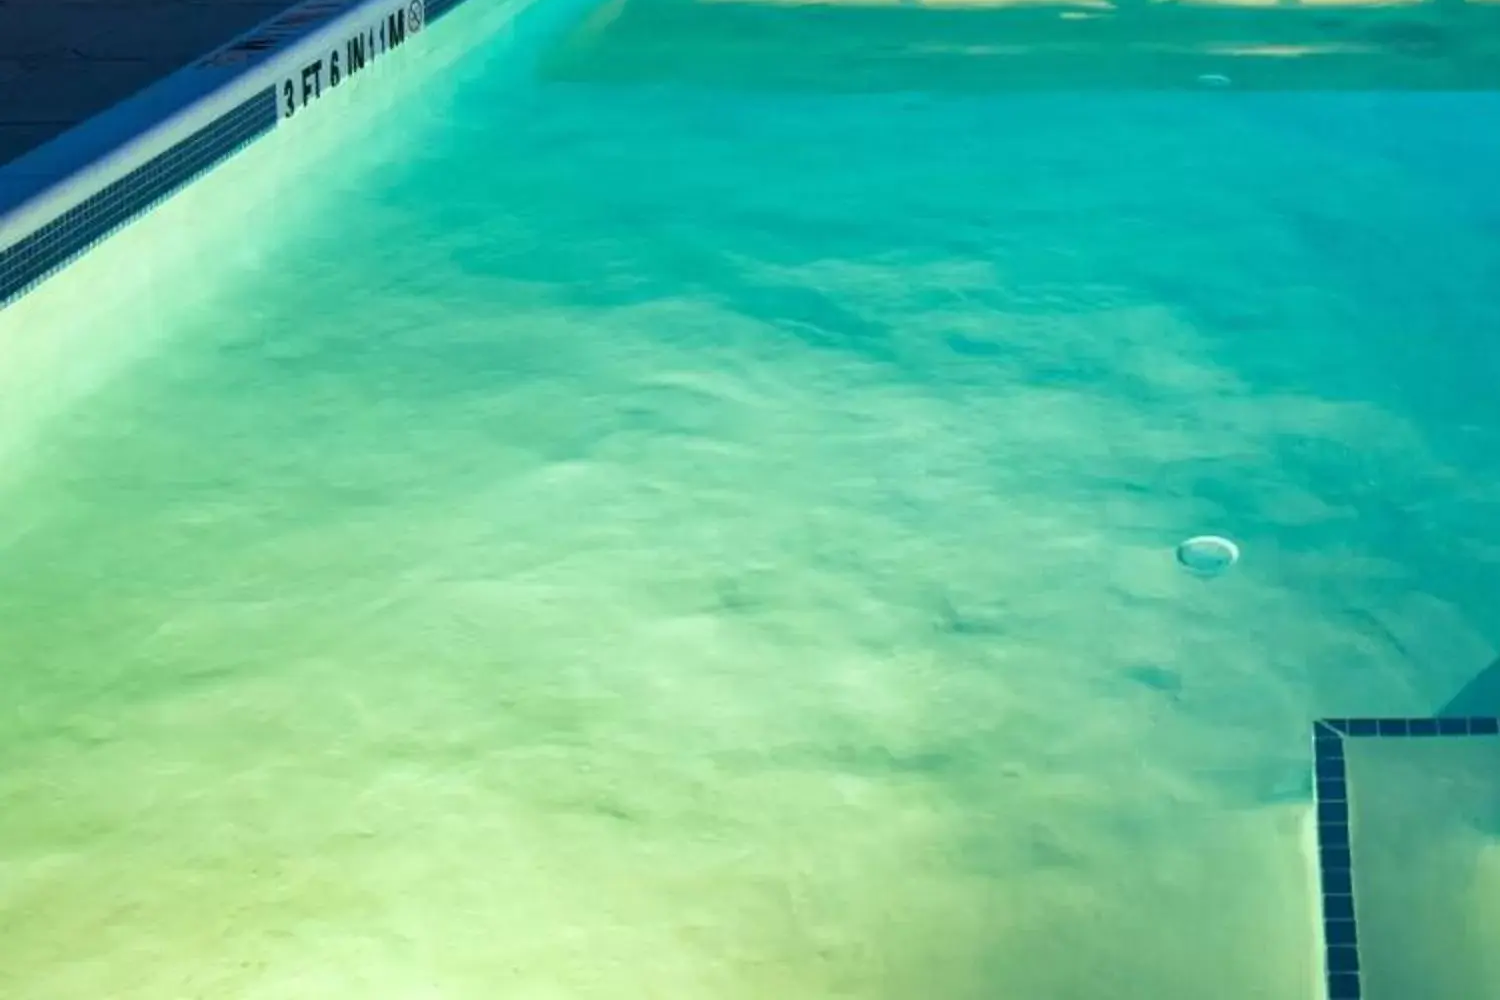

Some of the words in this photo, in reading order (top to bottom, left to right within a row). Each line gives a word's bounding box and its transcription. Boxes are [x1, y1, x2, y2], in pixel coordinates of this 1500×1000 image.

[284, 78, 295, 118] 3
[302, 59, 322, 108] FT
[330, 49, 341, 88] 6
[347, 31, 365, 77] IN
